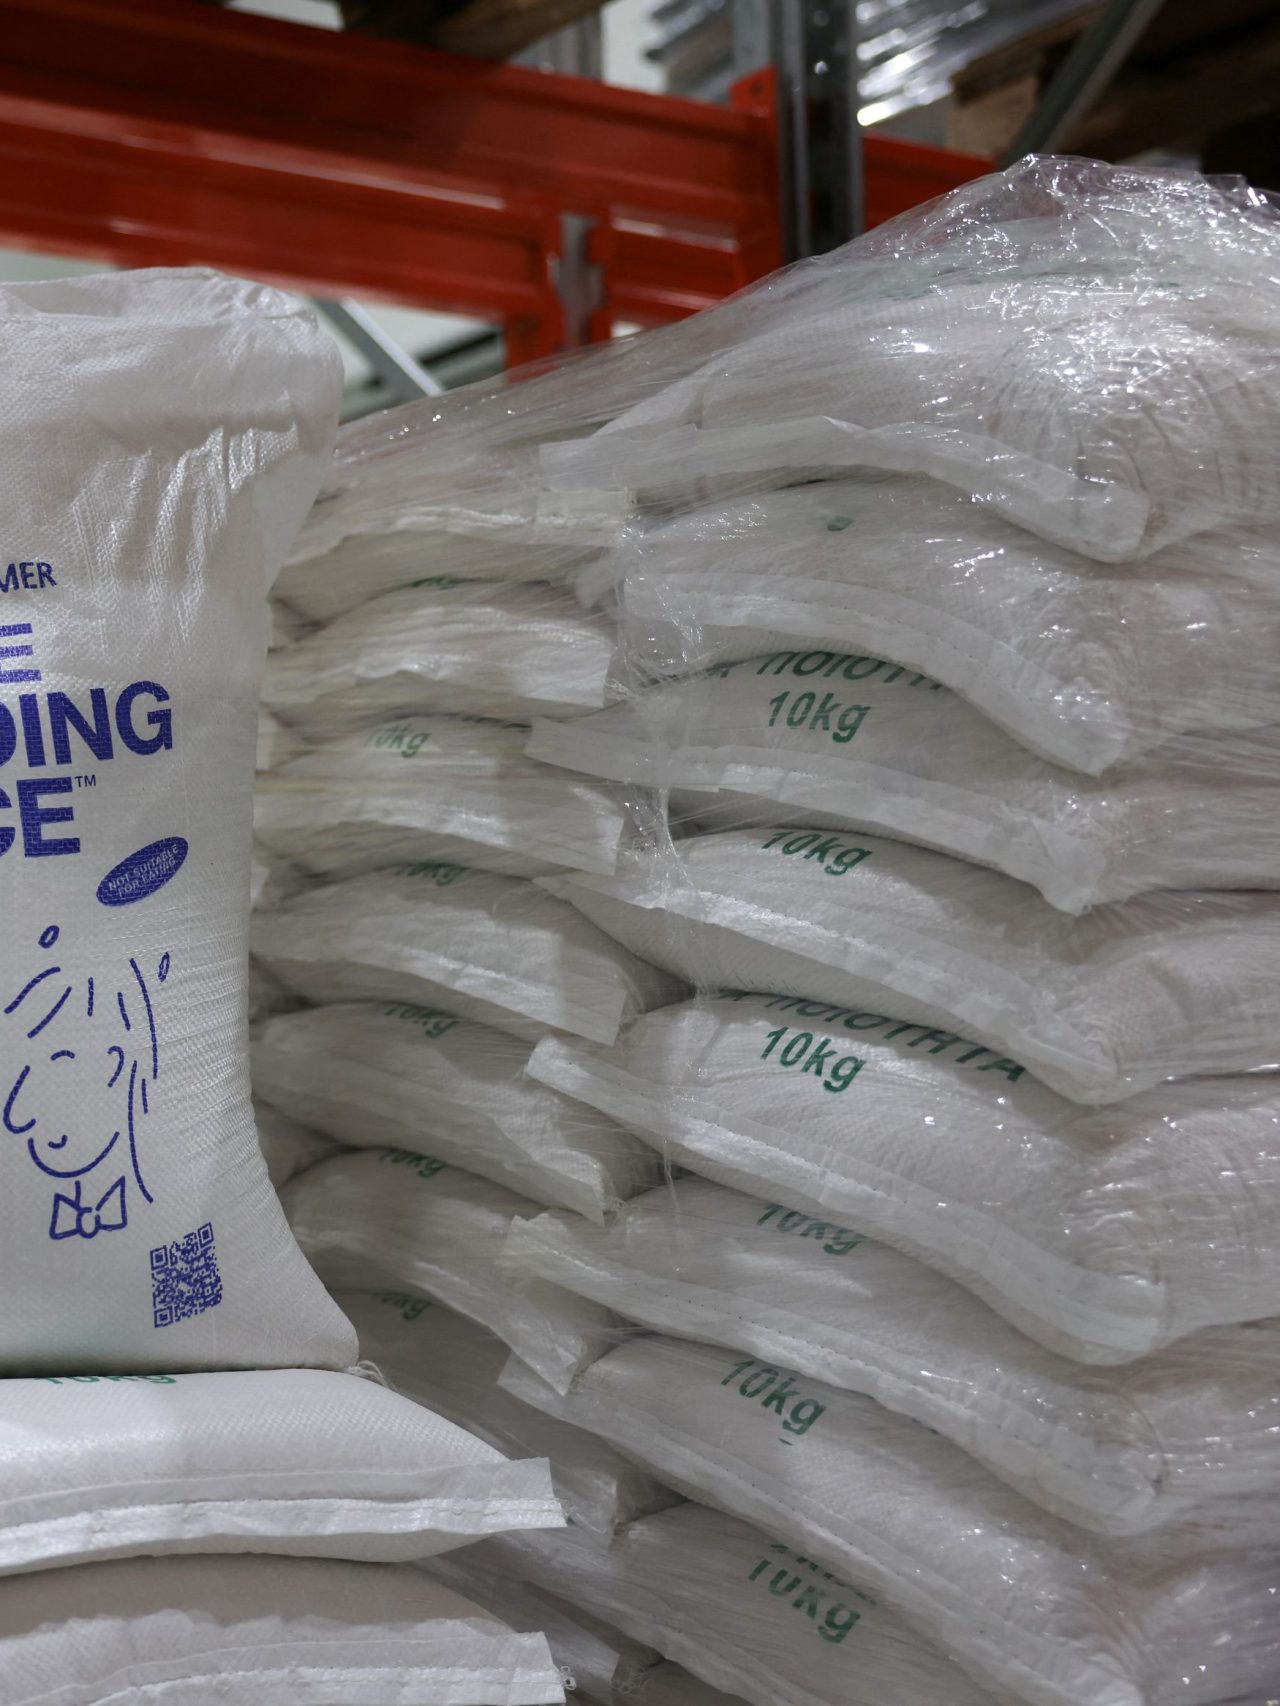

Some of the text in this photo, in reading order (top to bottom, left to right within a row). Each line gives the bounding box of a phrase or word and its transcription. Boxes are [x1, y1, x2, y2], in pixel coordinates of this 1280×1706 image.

[768, 691, 871, 743] 10kg
[108, 844, 179, 891] NOT SUITABLE
[762, 831, 872, 875] 10kg
[760, 1026, 866, 1092] 10kg
[721, 1360, 826, 1435] 10kg
